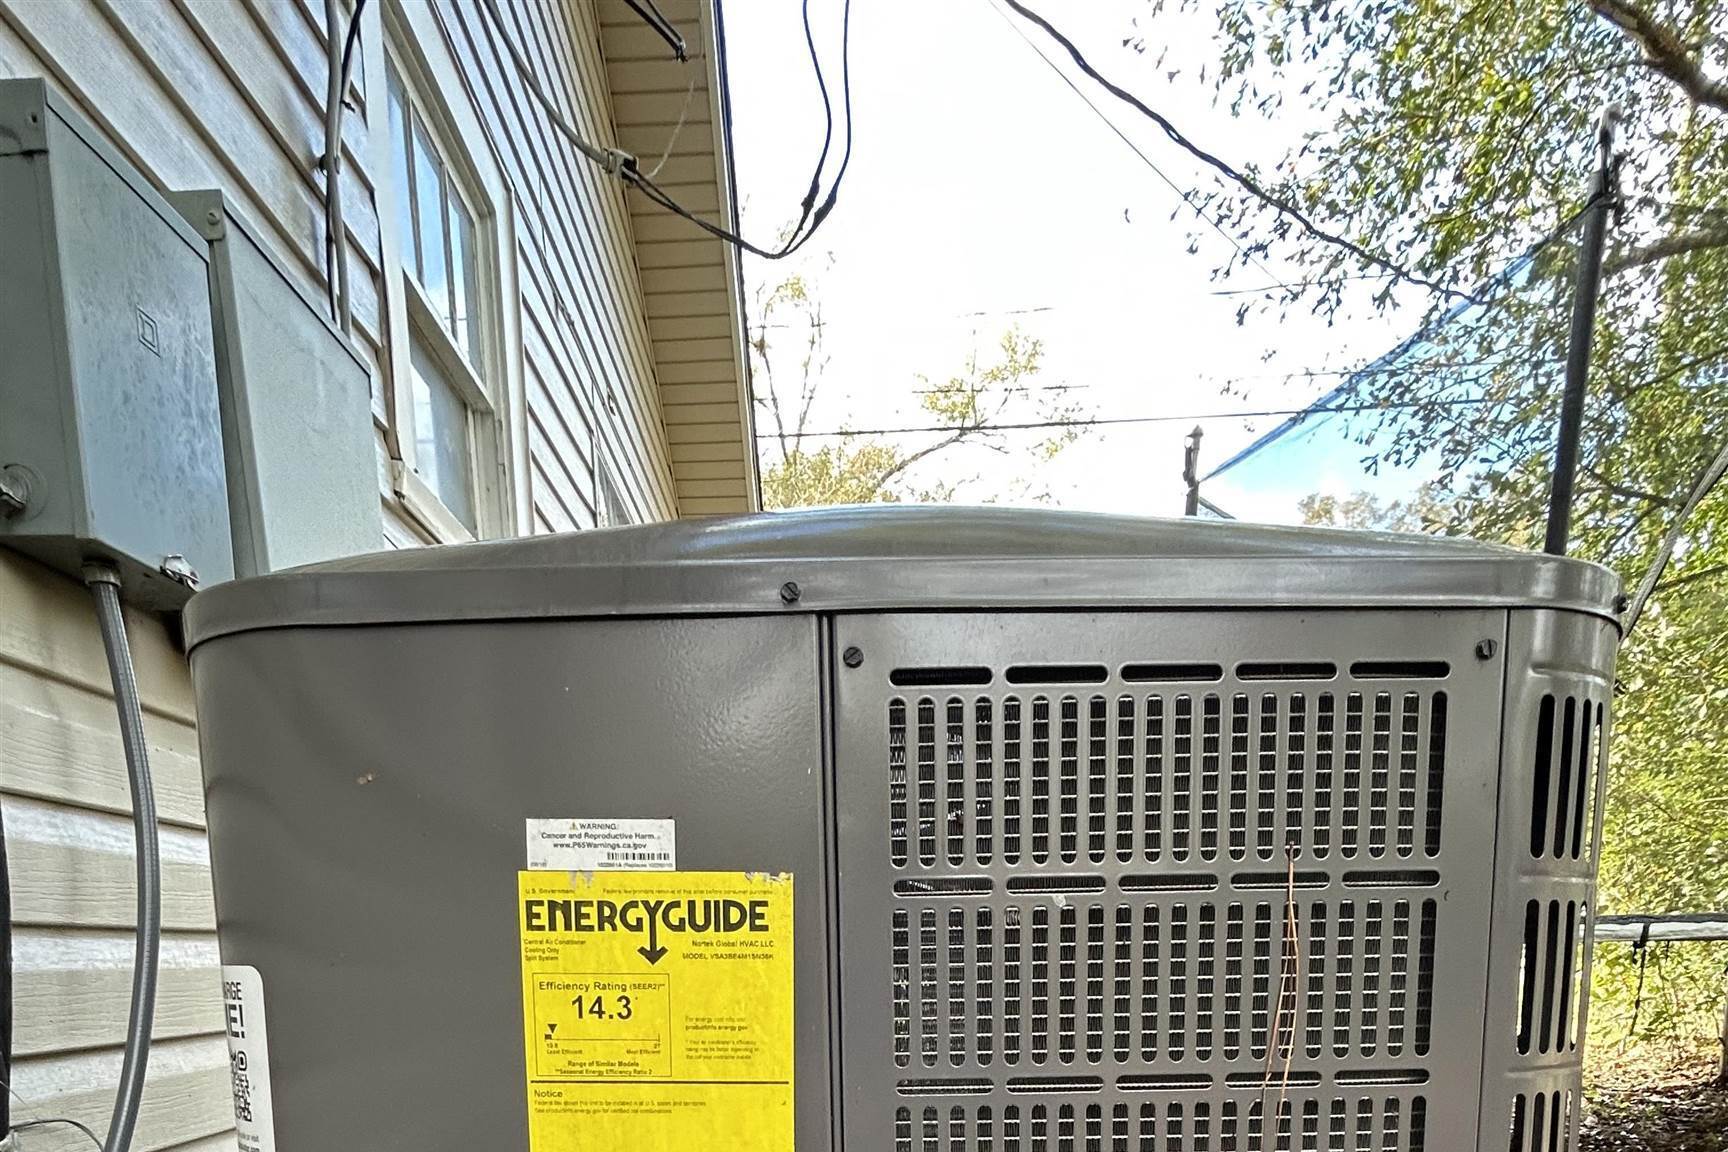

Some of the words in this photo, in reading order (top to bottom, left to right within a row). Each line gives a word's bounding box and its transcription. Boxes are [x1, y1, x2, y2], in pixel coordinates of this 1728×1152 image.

[541, 832, 567, 840] Cancer
[568, 832, 582, 840] and
[584, 832, 633, 841] Reproductive
[553, 841, 647, 850] www.P65Warnings.ca.gov
[525, 899, 769, 933] ENERGYGUIDE
[740, 940, 759, 948] HVAC
[760, 940, 774, 948] LLC
[683, 952, 709, 960] MODEL
[539, 981, 590, 993] Efficiency
[593, 981, 627, 993] Rating
[567, 1060, 587, 1068] Range
[534, 1089, 563, 1098] Notice
